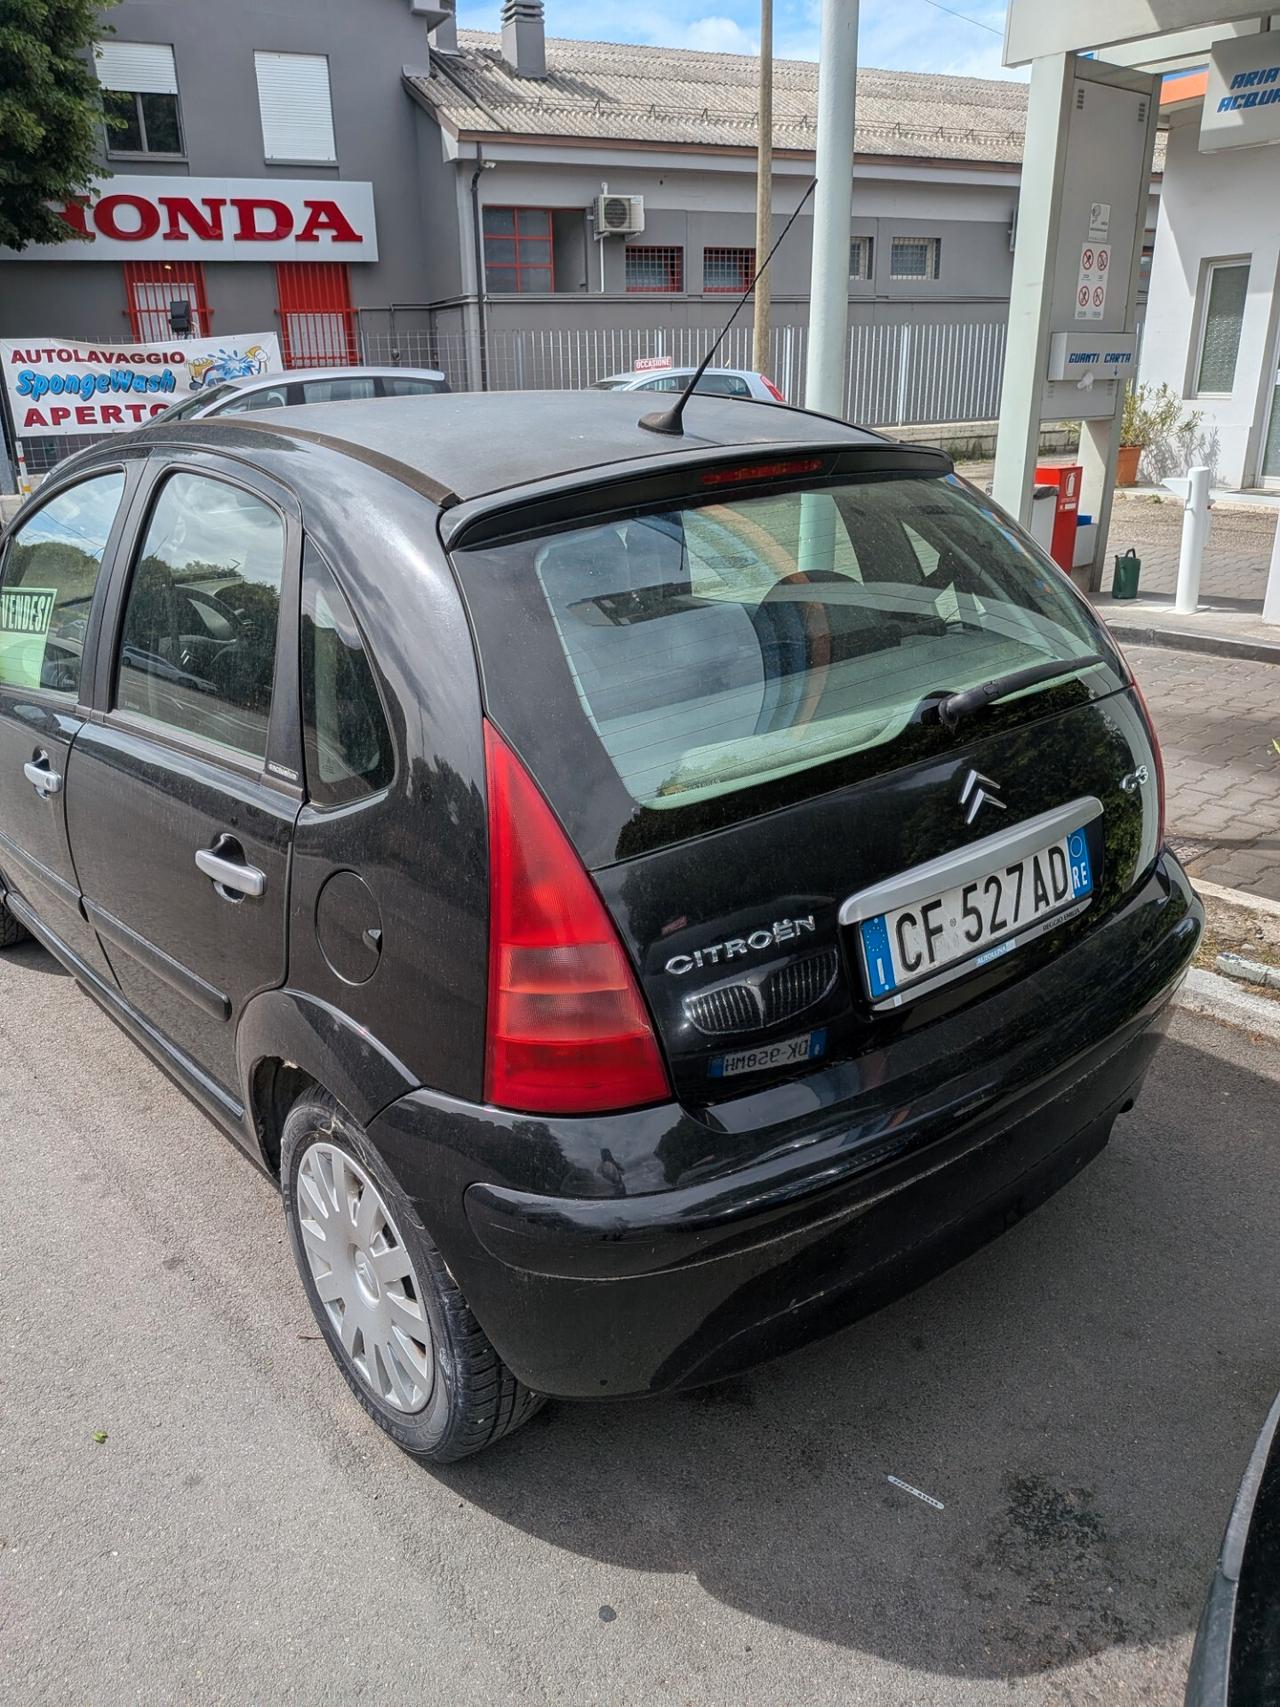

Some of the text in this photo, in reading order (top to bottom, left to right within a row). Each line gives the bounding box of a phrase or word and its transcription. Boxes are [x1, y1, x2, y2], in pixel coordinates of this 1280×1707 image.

[1230, 67, 1280, 90] ARIA
[11, 348, 186, 364] AUTOLAVAGGIO
[636, 358, 671, 369] OCCASIONE
[1068, 352, 1131, 364] GUANTI CARTA
[15, 368, 177, 402] SpongeWash
[2, 594, 52, 632] VENDESI
[896, 899, 943, 972] CF
[962, 846, 1068, 942] 527AD
[1072, 862, 1088, 889] RE
[665, 915, 816, 975] CITROËN
